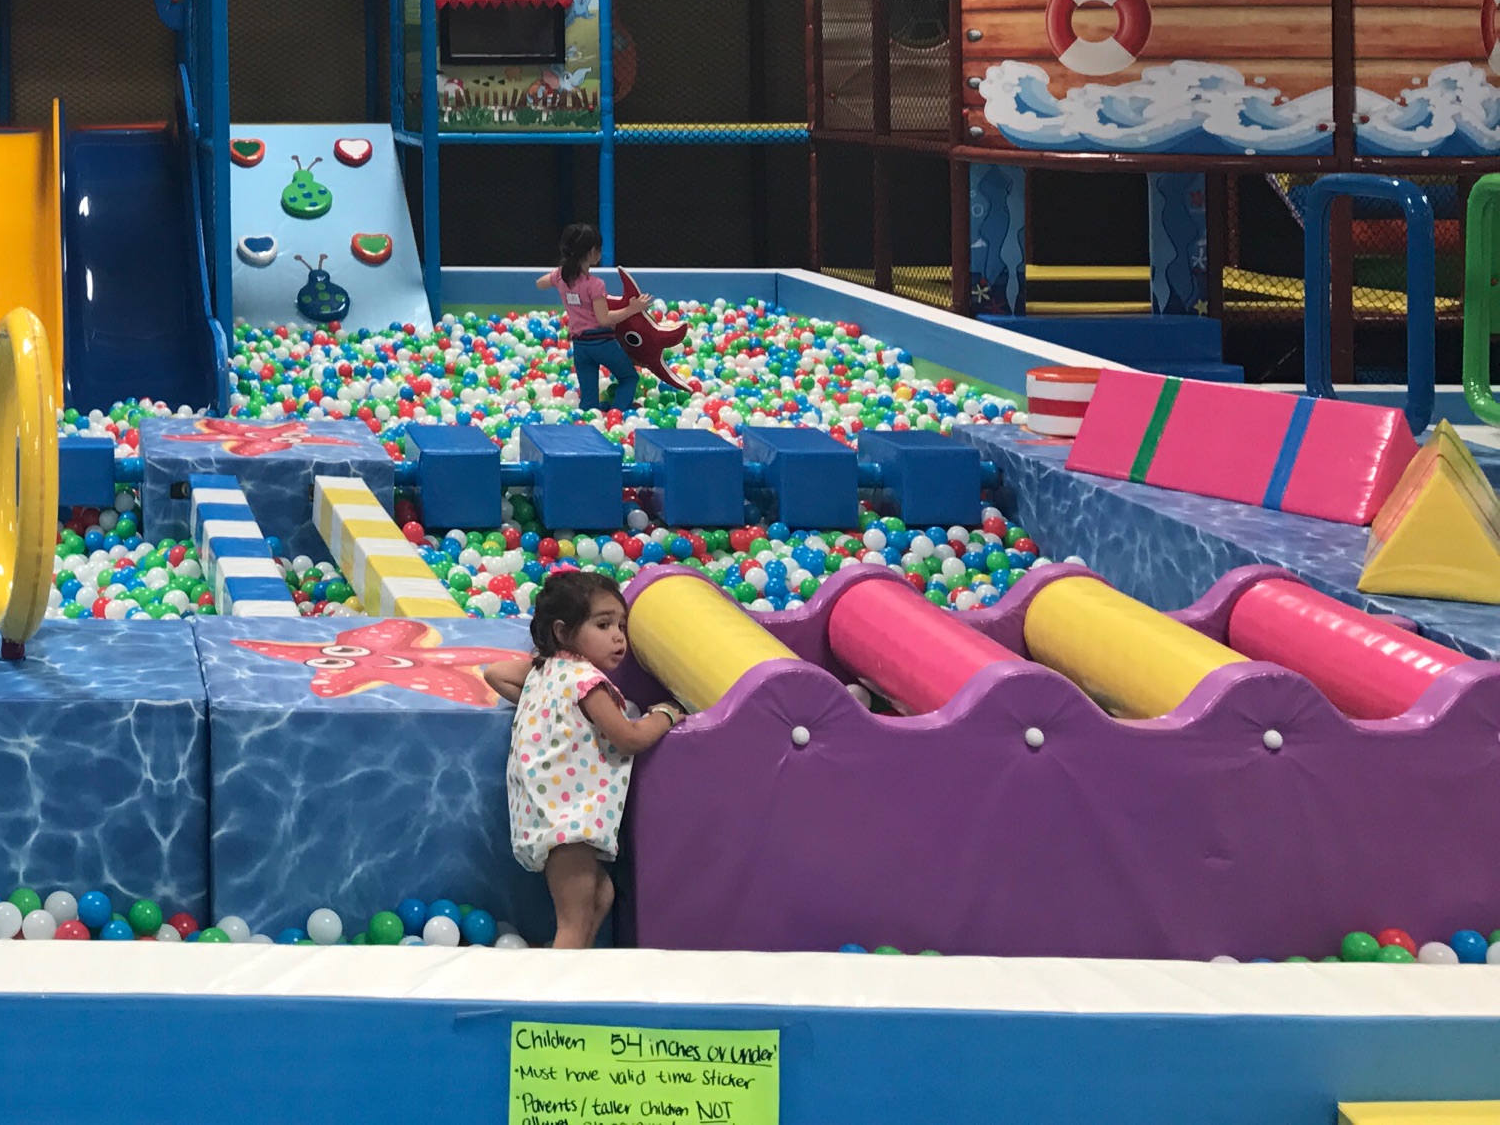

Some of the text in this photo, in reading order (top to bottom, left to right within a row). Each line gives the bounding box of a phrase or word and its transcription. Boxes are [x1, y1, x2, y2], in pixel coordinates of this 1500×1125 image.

[515, 1028, 586, 1052] Children
[610, 1033, 643, 1058] 54
[648, 1038, 702, 1062] inches
[707, 1044, 728, 1063] or
[565, 1067, 601, 1083] have
[608, 1068, 647, 1086] valid
[655, 1070, 698, 1085] time
[695, 1100, 734, 1121] NOT
